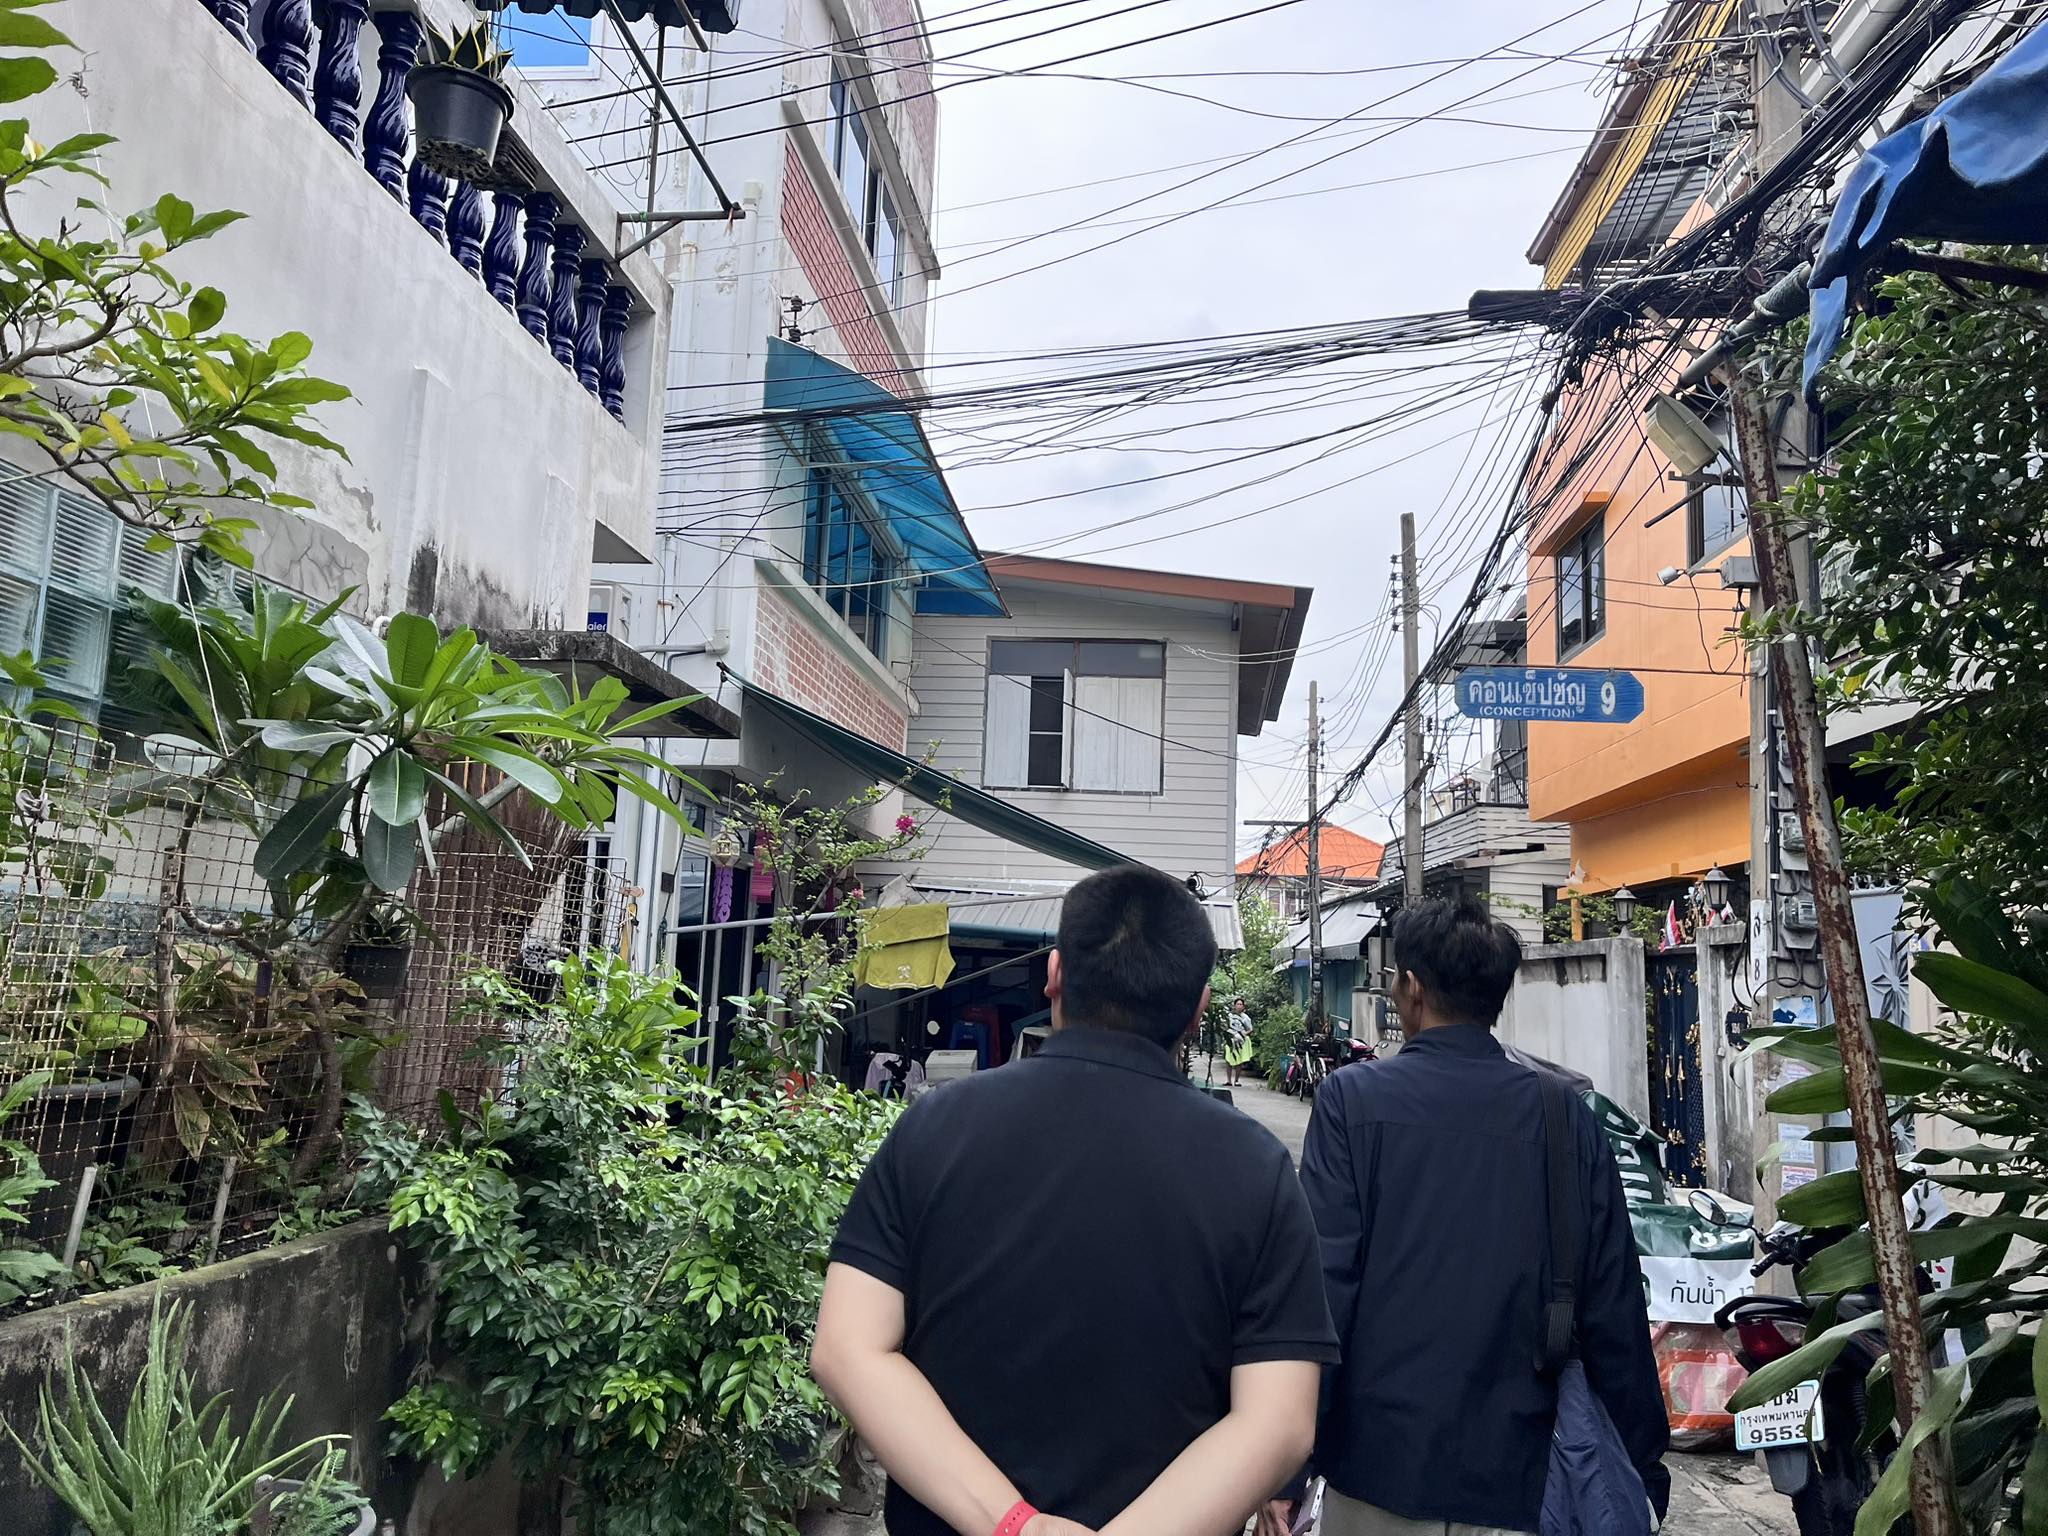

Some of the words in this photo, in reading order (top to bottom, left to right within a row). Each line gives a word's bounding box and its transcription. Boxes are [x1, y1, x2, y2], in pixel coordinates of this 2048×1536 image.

[1600, 680, 1616, 716] 9
[1479, 705, 1575, 719] (CONCEPTION)
[1670, 1276, 1726, 1305] กันน้ำ
[1750, 1424, 1807, 1444] 9553
